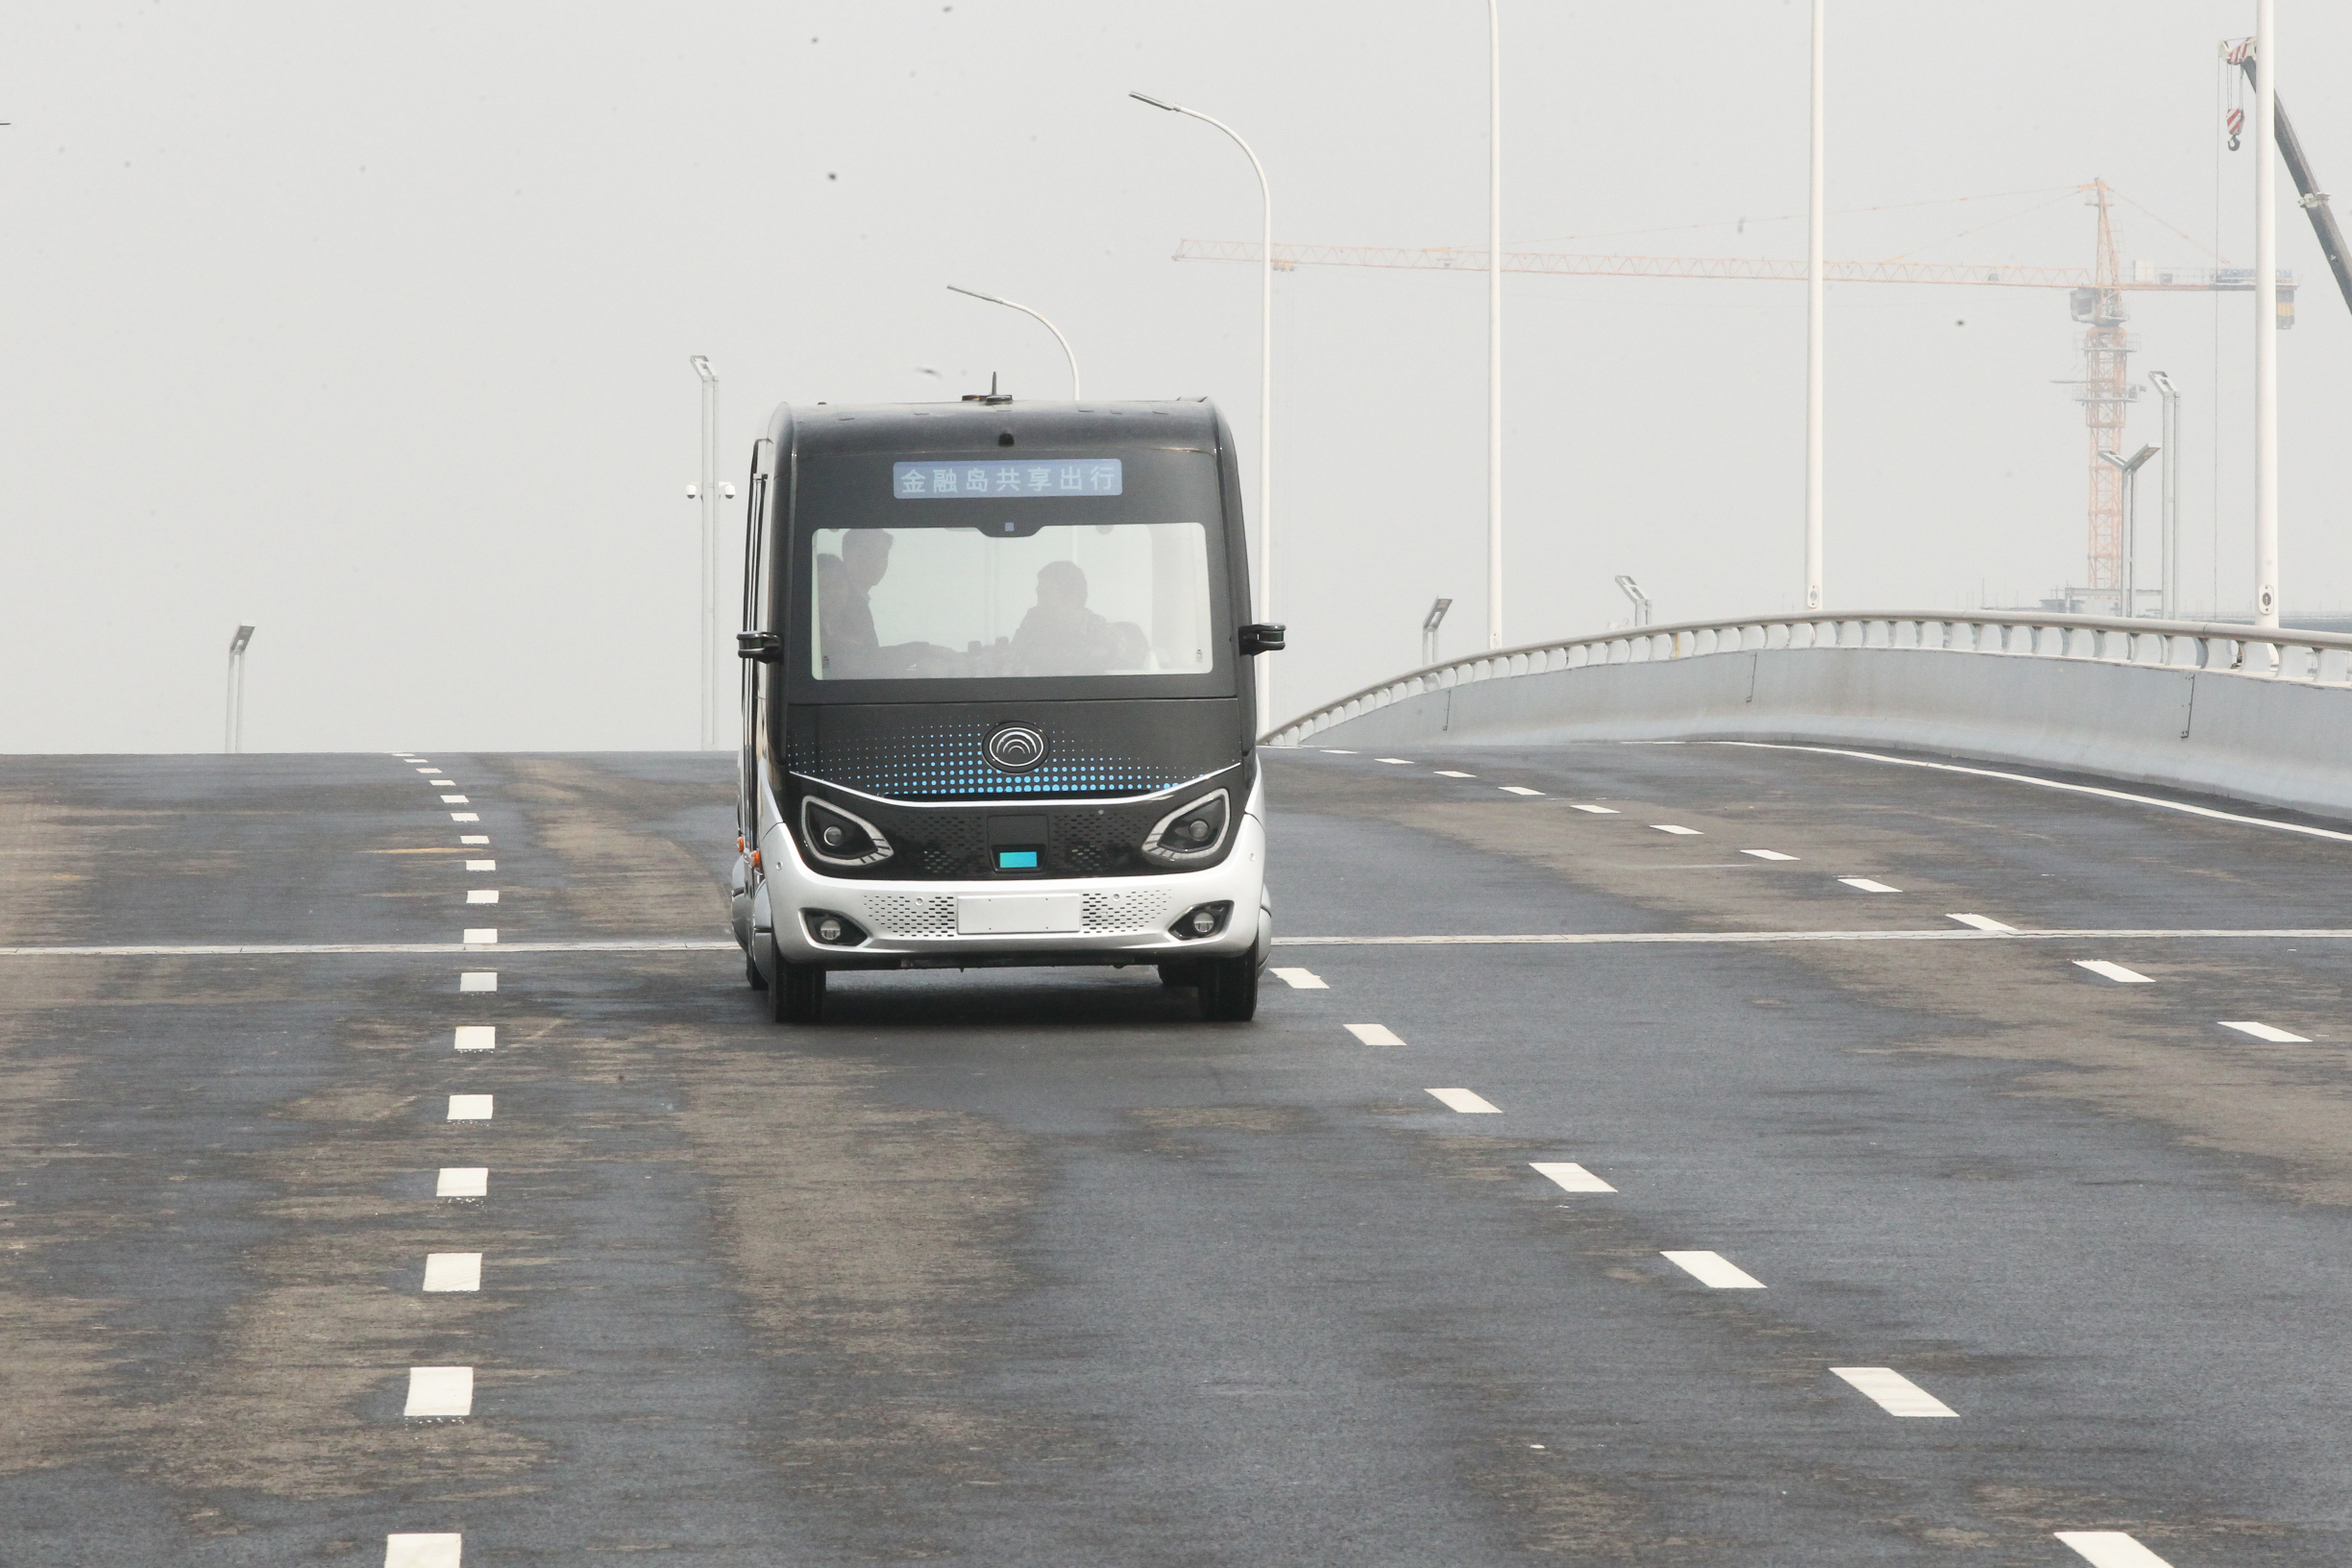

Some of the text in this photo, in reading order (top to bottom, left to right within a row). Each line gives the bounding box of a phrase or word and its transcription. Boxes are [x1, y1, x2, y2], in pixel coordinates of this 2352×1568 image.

[900, 466, 1115, 494] 金融岛共享出行
